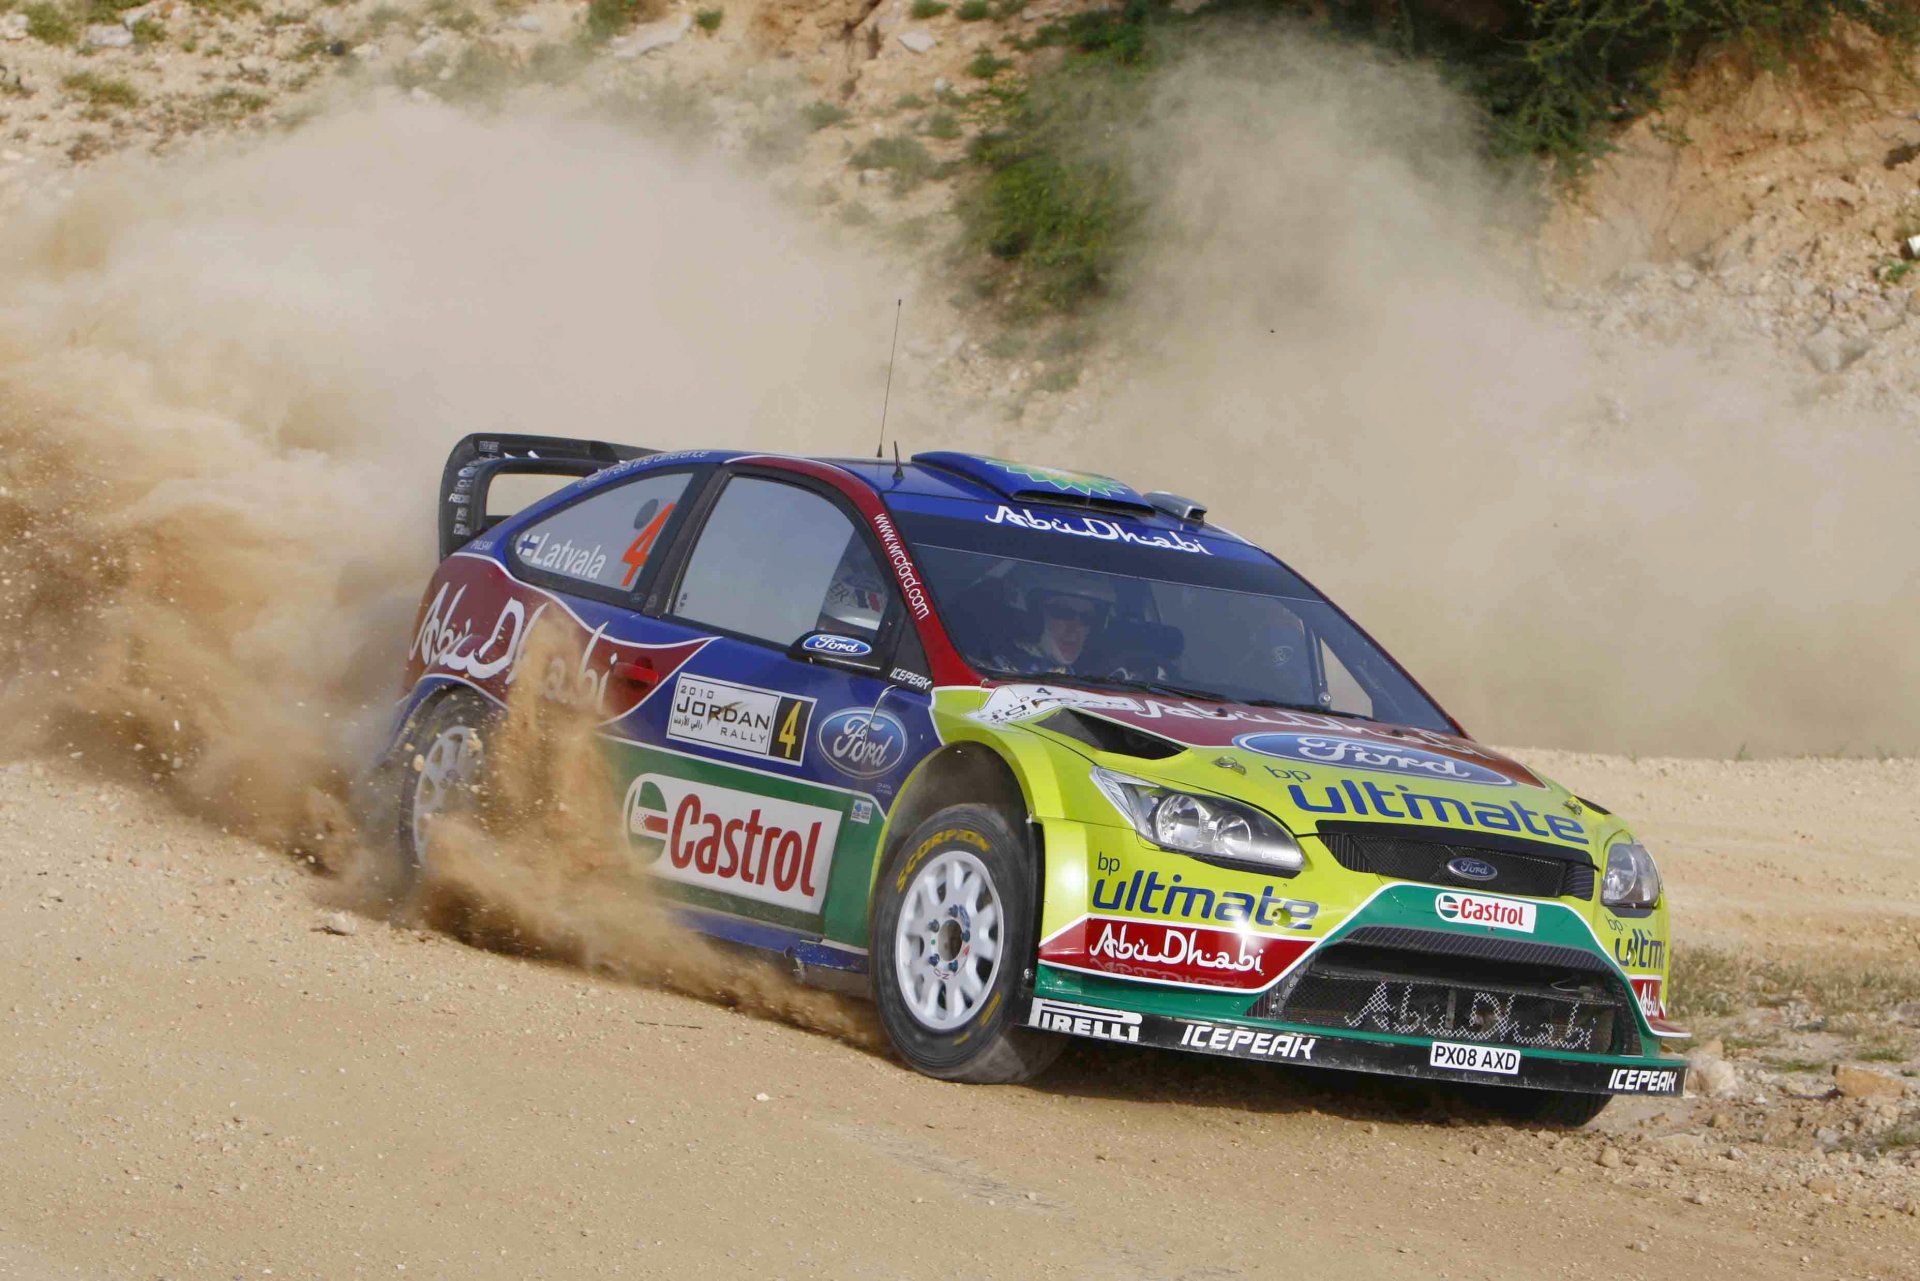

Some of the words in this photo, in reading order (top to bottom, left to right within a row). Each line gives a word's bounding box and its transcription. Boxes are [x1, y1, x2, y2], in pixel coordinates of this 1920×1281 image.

[621, 503, 675, 586] 4
[984, 505, 1078, 536] Abu
[1077, 518, 1213, 555] Dhabi
[530, 533, 607, 579] Latvala
[873, 513, 930, 620] www.wrcford.com
[815, 633, 859, 654] Ford
[680, 685, 714, 699] 2010
[890, 667, 932, 690] ICEPEAK
[676, 697, 770, 731] JORDAN
[778, 700, 802, 758] 4
[720, 726, 767, 743] RALLY
[833, 714, 889, 769] Ford
[1264, 765, 1312, 783] bp
[1297, 735, 1472, 780] Ford
[1288, 779, 1590, 845] ultimate
[670, 794, 822, 897] Castrol
[1098, 851, 1121, 874] bp
[1461, 863, 1489, 877] Ford
[1093, 870, 1320, 930] ultimate
[1460, 898, 1523, 926] Castrol
[1605, 915, 1624, 934] bp
[1089, 922, 1163, 963] Abu
[1160, 929, 1265, 973] Dhabi
[1027, 997, 1142, 1043] PIRELLI
[1181, 1023, 1316, 1061] ICEPEAK
[1433, 1044, 1477, 1068] PX08
[1481, 1051, 1517, 1073] AXD
[1608, 1068, 1678, 1093] ICEPEAK
